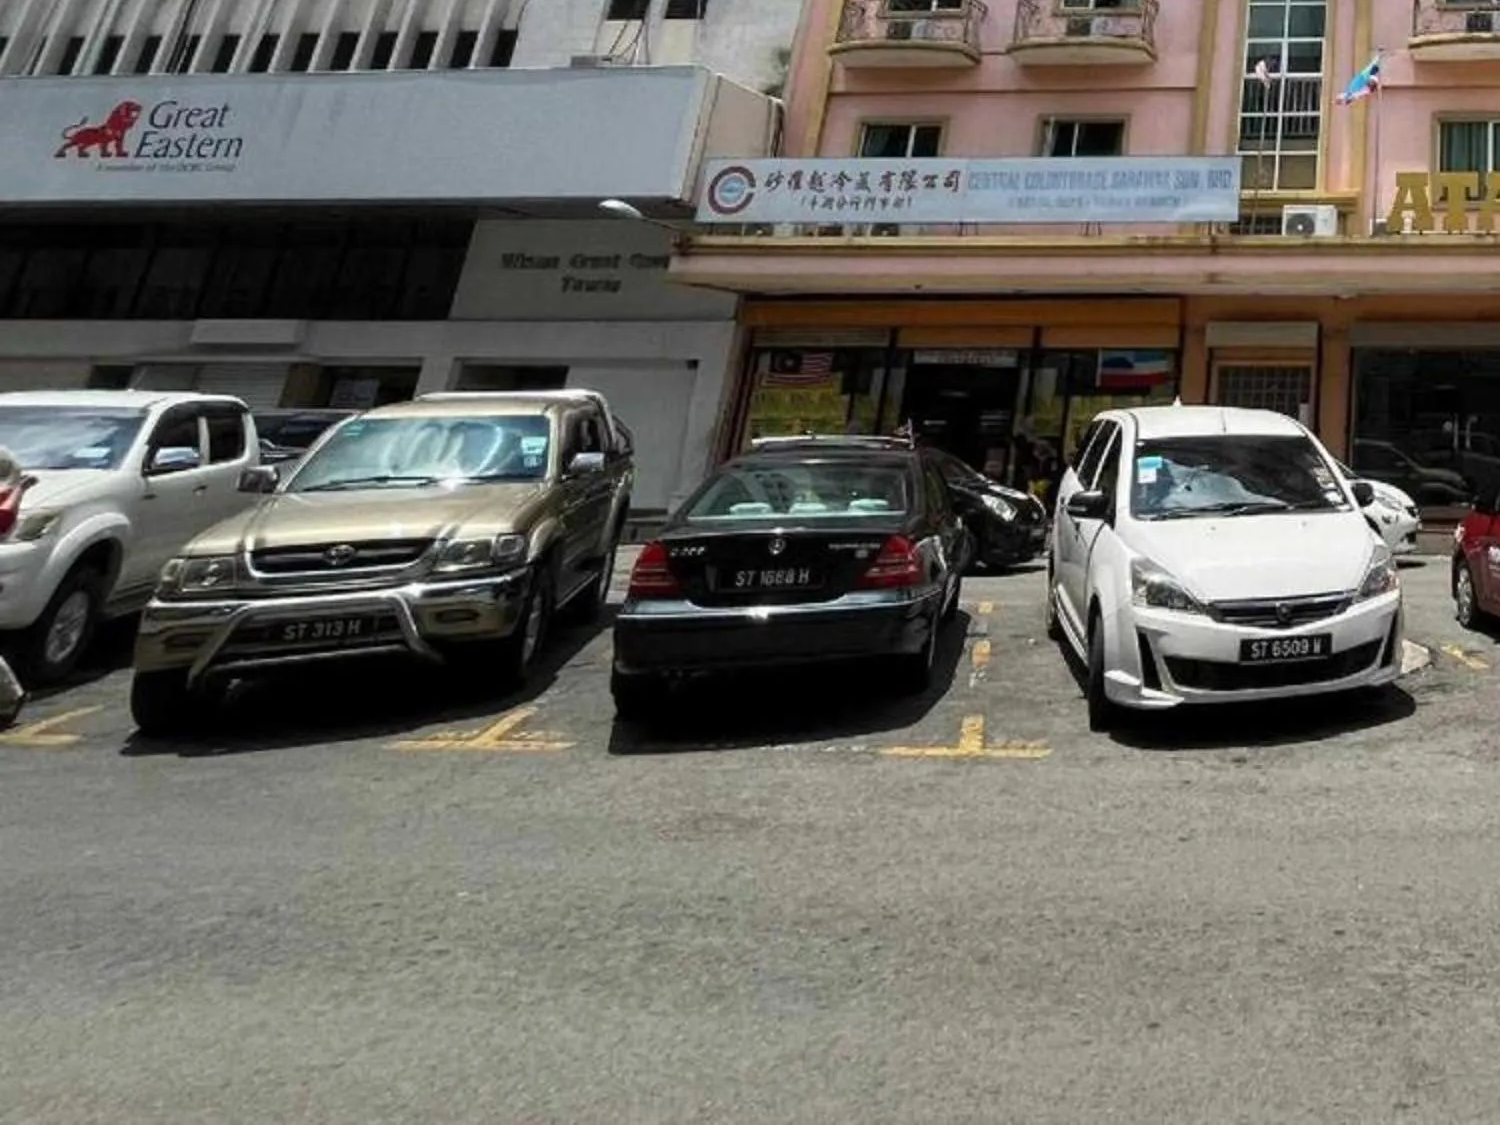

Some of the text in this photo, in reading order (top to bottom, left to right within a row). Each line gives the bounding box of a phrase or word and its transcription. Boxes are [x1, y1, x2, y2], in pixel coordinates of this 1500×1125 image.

[149, 100, 231, 129] Great
[134, 131, 243, 158] Eastern
[283, 622, 308, 641] ST
[1250, 641, 1268, 659] ST
